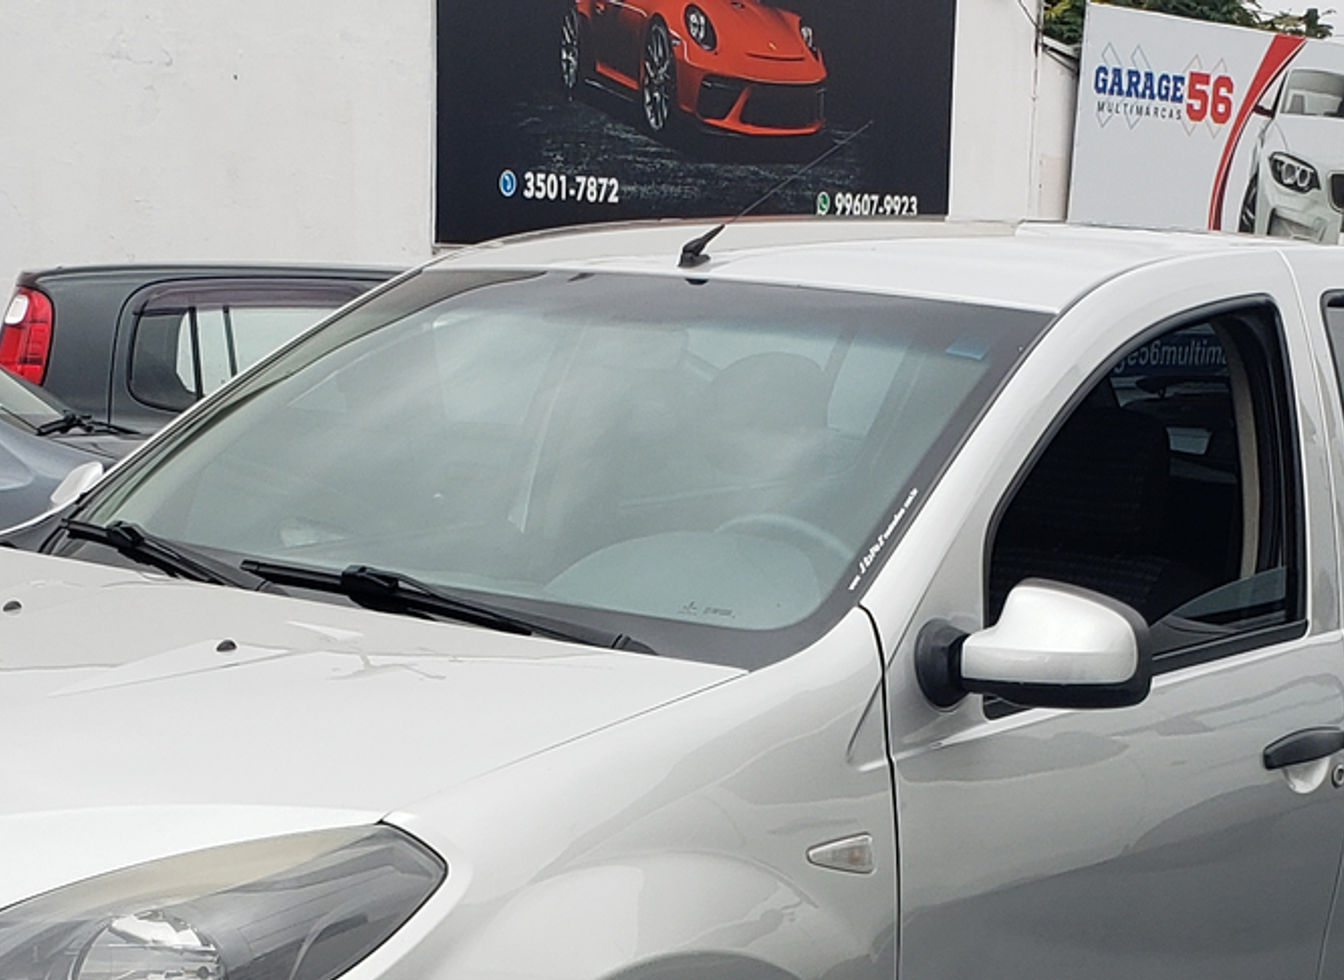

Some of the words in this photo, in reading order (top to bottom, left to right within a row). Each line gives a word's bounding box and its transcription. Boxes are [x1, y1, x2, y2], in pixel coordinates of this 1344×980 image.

[1096, 101, 1182, 121] MULTIMARCAS
[523, 171, 620, 203] 3501-7872
[834, 193, 918, 216] 99607-9923
